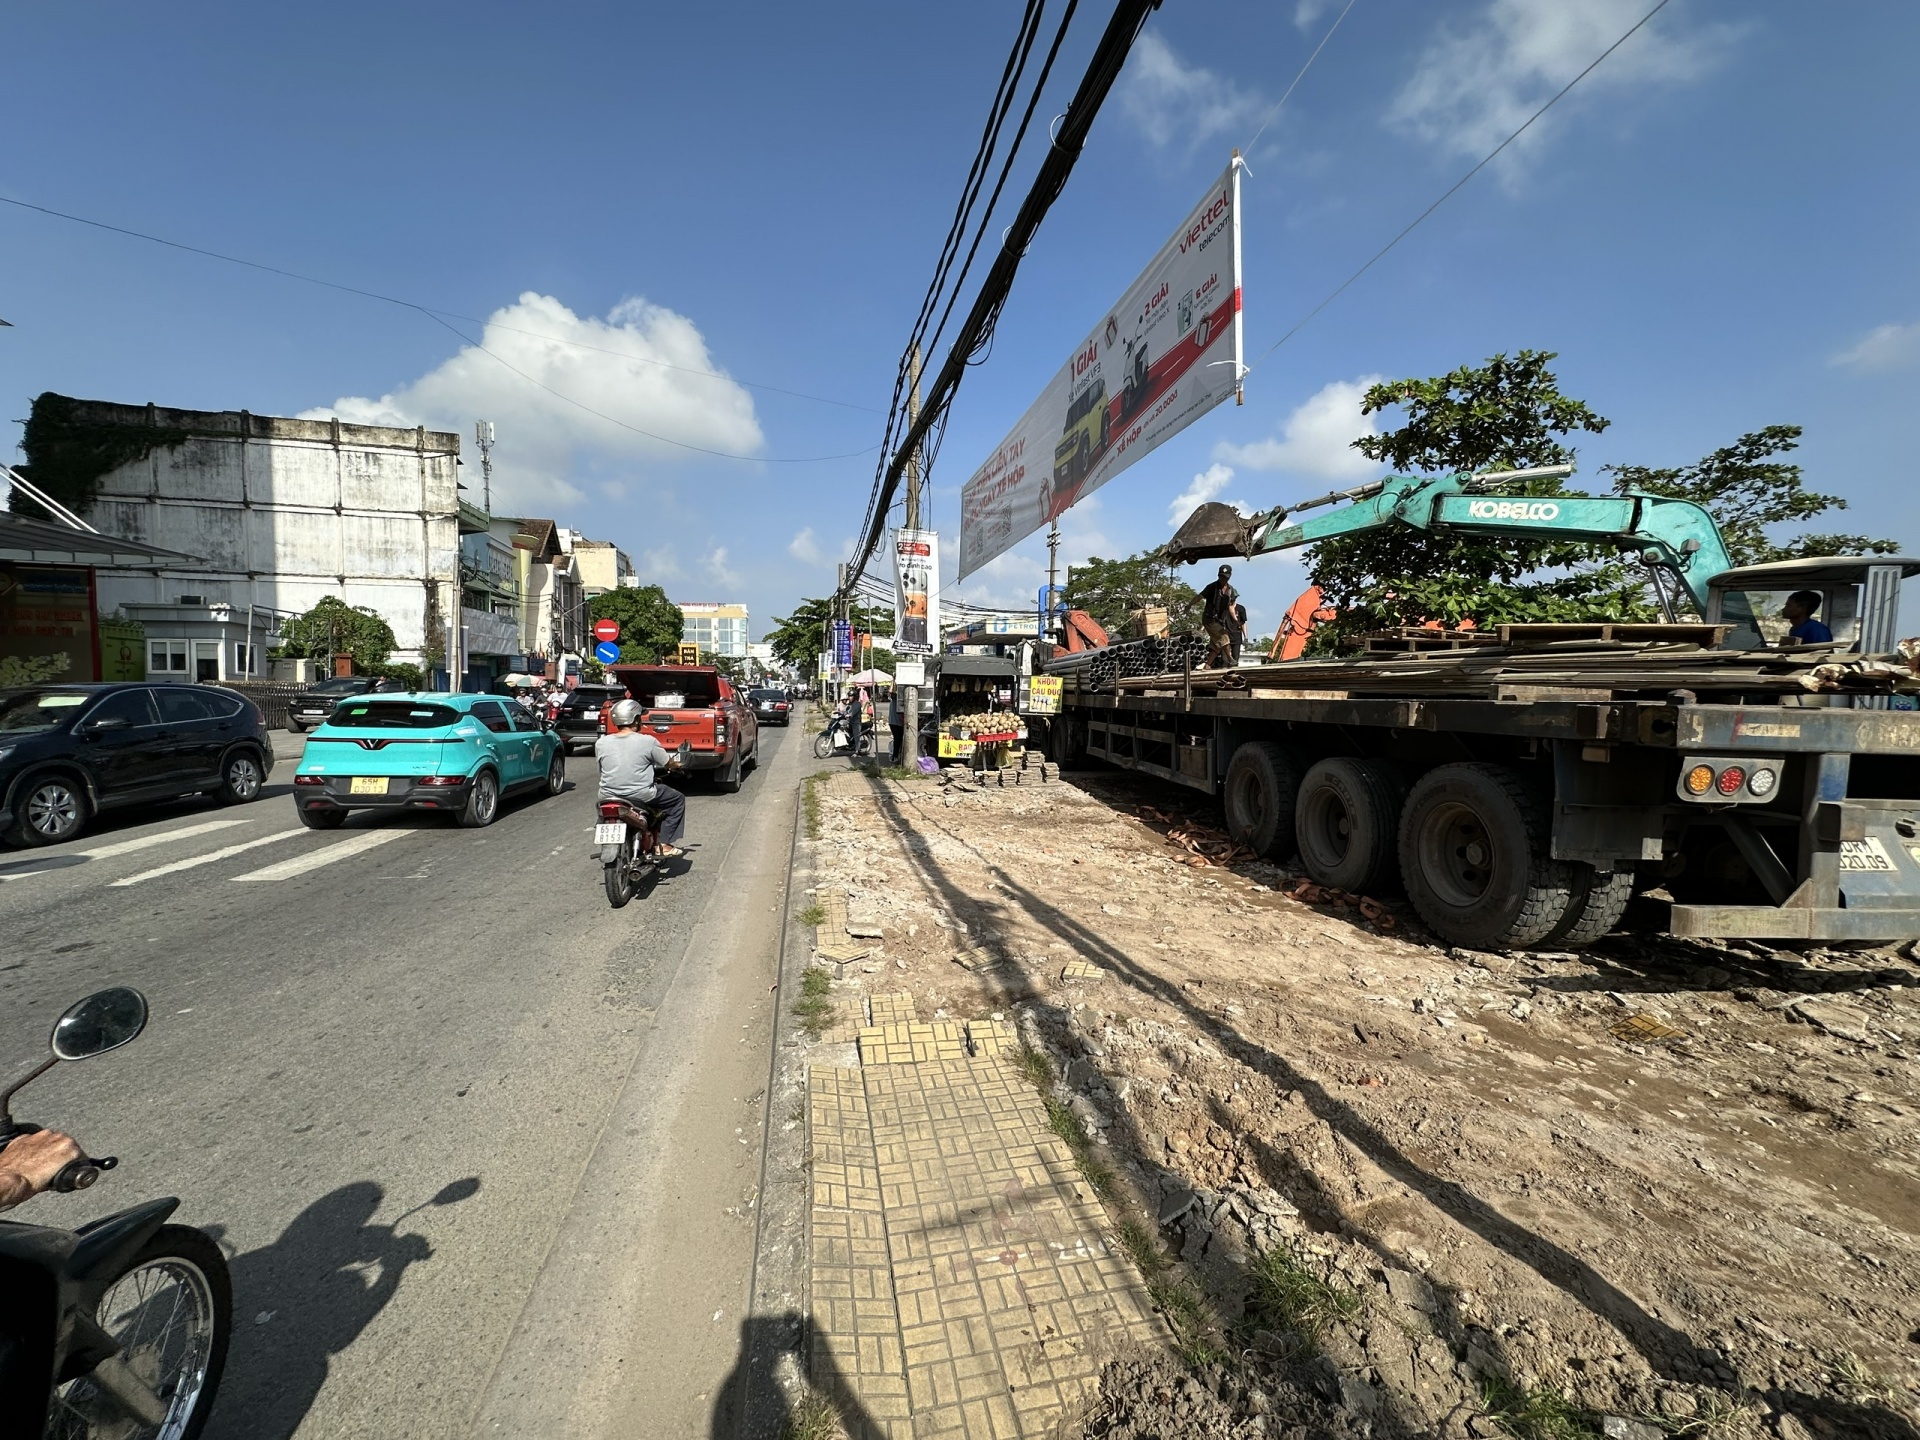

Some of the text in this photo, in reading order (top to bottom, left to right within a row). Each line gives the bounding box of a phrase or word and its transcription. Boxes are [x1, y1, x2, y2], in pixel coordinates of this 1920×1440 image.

[1179, 189, 1230, 254] viettel
[1198, 215, 1230, 252] telecom
[1144, 282, 1169, 317] 2 GIẢI
[1070, 339, 1098, 382] 1 GIẢI
[1468, 501, 1559, 520] KOBELCO
